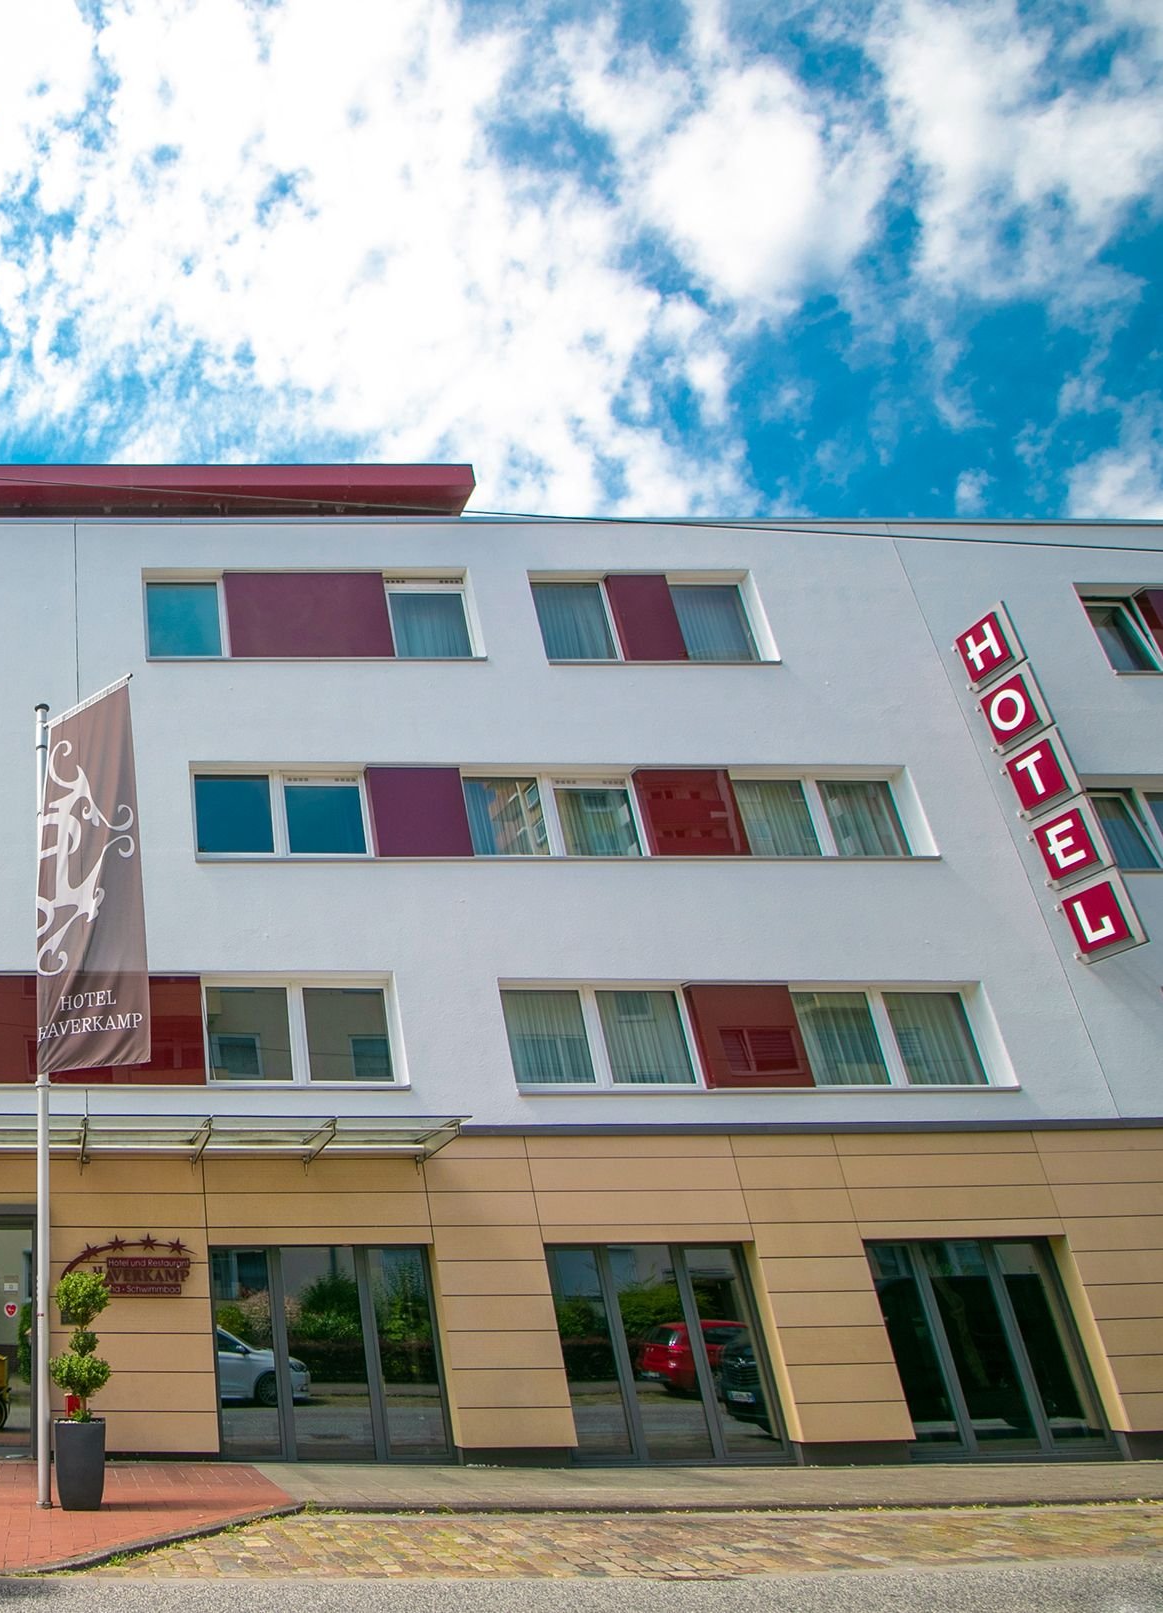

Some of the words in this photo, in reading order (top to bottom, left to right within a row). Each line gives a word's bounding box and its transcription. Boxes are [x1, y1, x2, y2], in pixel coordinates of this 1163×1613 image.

[966, 621, 1116, 944] HOTEL
[59, 989, 117, 1012] HOTEL
[37, 1012, 143, 1042] HAVERKAMP
[108, 1259, 129, 1267] Hotel
[130, 1259, 146, 1267] und
[148, 1259, 190, 1267] Restaurant
[126, 1285, 180, 1293] Schwimmbad
